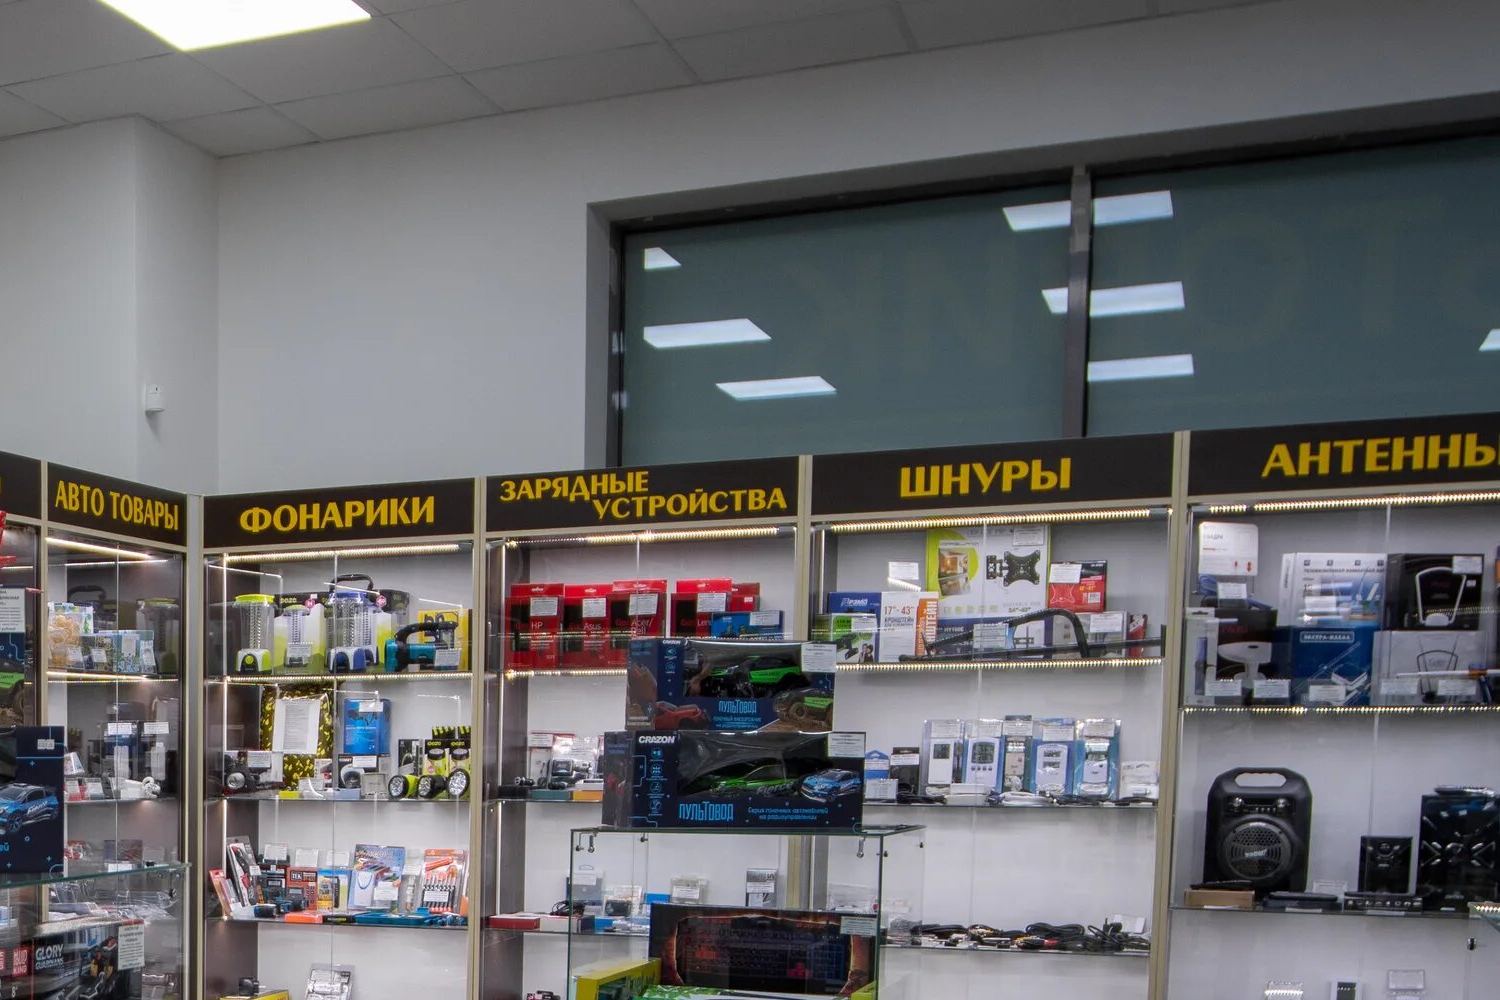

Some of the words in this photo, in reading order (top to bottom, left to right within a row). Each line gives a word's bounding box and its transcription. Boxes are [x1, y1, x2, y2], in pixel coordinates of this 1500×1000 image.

[499, 470, 649, 503] ЗАРЯДНЫЕ
[900, 457, 1072, 498] ШНУРЫ
[55, 480, 105, 516] АВТО
[110, 491, 179, 531] ТОВАРЫ
[239, 496, 436, 533] ФОНАРИКИ
[592, 486, 788, 521] УСТРОЙСТВА
[638, 735, 676, 744] CRAZON
